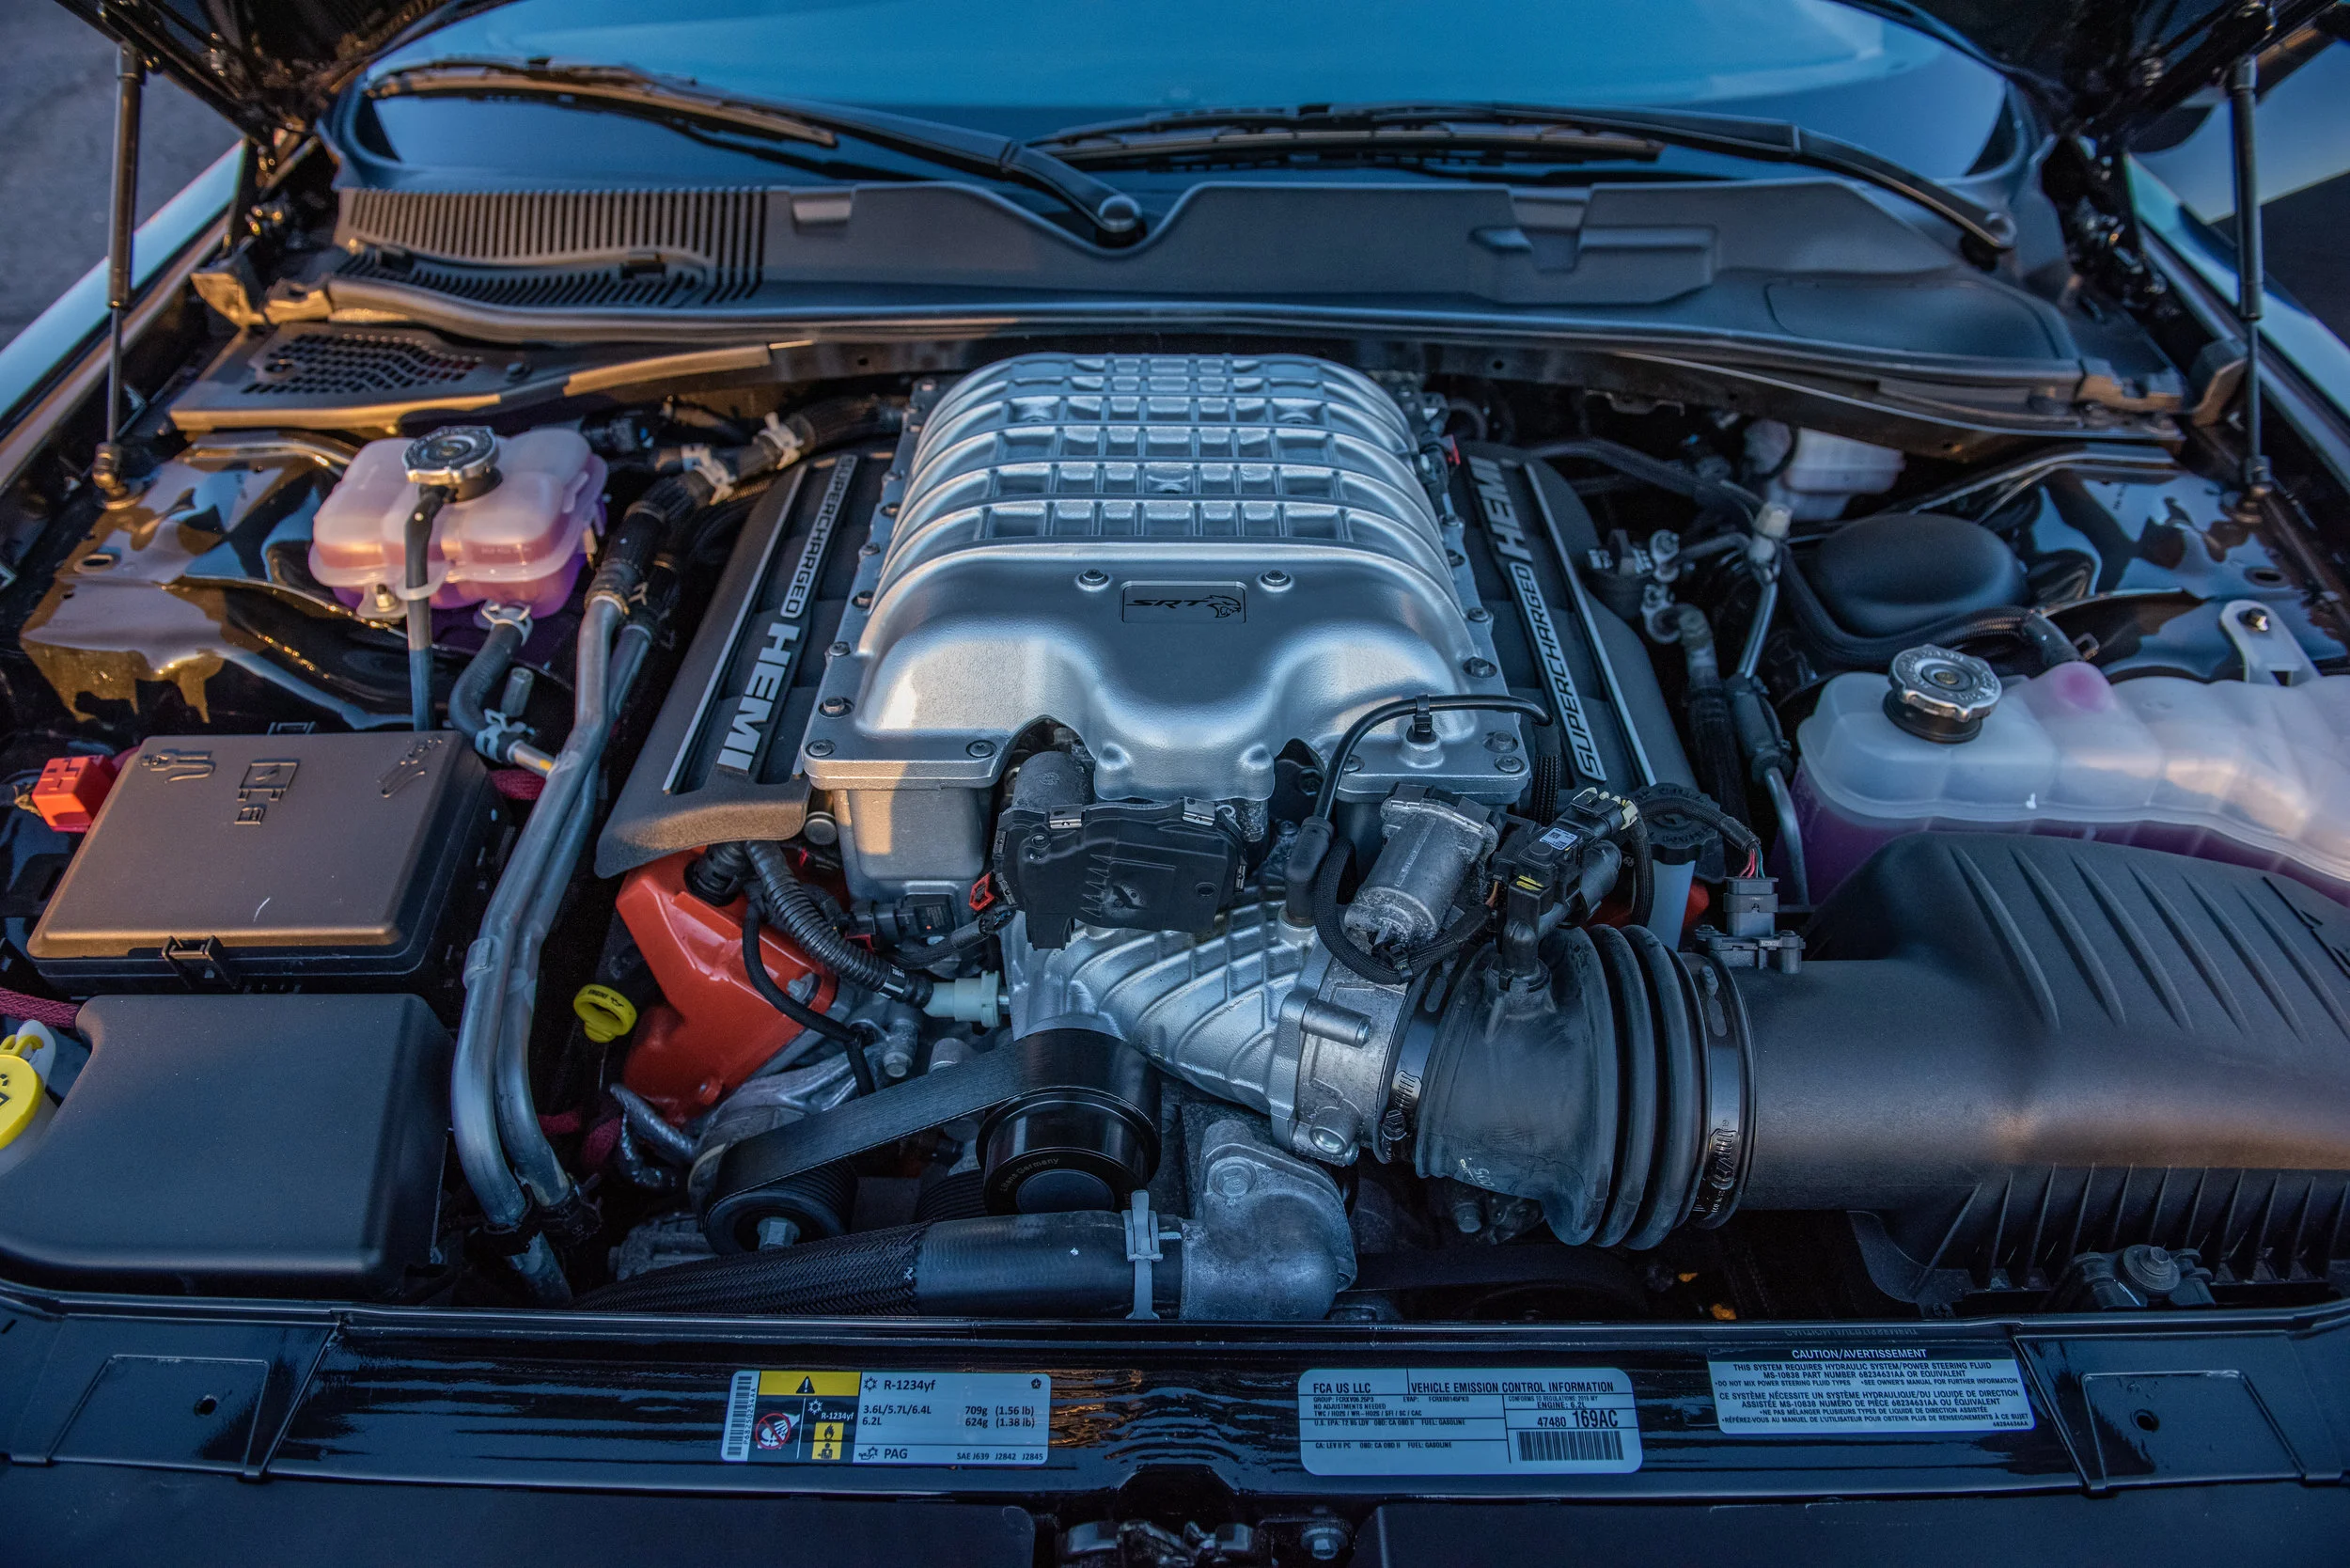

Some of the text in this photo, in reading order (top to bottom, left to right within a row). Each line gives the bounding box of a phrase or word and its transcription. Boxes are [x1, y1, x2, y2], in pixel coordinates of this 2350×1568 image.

[1468, 457, 1532, 563] HEMI
[785, 457, 854, 614] SUPERCHARGED
[1126, 599, 1208, 609] SRT
[1513, 564, 1601, 778] SUPERCHARGED
[717, 622, 801, 773] HEMI
[1792, 1348, 1926, 1359] CAUTION/AVERTISSEMENT
[1732, 1363, 1752, 1372] THIS
[884, 1380, 936, 1391] R-1234yf
[1313, 1383, 1332, 1394] FCA
[1353, 1383, 1371, 1394] LLC
[1410, 1381, 1615, 1393] VEHICLE EMISSION CONTROL INFORMATION
[1730, 1391, 1766, 1400] SYSTÈME
[1768, 1390, 1810, 1400] NÉCESSITE
[1825, 1390, 1860, 1399] SYSTÈME
[1861, 1389, 1931, 1399] HYDRAULIQUE/DU
[1933, 1389, 1964, 1398] LIQUIDE
[1978, 1388, 2020, 1398] DIRECTION
[1741, 1400, 1777, 1408] ASSISTÉE
[1778, 1399, 1816, 1408] MS-10838
[1818, 1399, 1852, 1407] NUMÉRO
[1867, 1398, 1889, 1407] PIÈCE
[1891, 1398, 1938, 1406] 68234631AA
[1953, 1397, 2000, 1406] ÉQUIVALENT
[863, 1405, 932, 1415] 3.6L/5.7L/6.4L
[964, 1406, 1034, 1416] 709g (1.56 lb)
[743, 1388, 757, 1445] P68250254AA
[821, 1412, 854, 1420] R-1234yf
[862, 1417, 883, 1426] 6.2L
[1536, 1409, 1618, 1427] 47480 169AC
[964, 1418, 1035, 1428] 624g (1.38 lb)
[884, 1449, 908, 1460] PAG
[956, 1452, 1043, 1462] SAE J639 J2842 J2845
